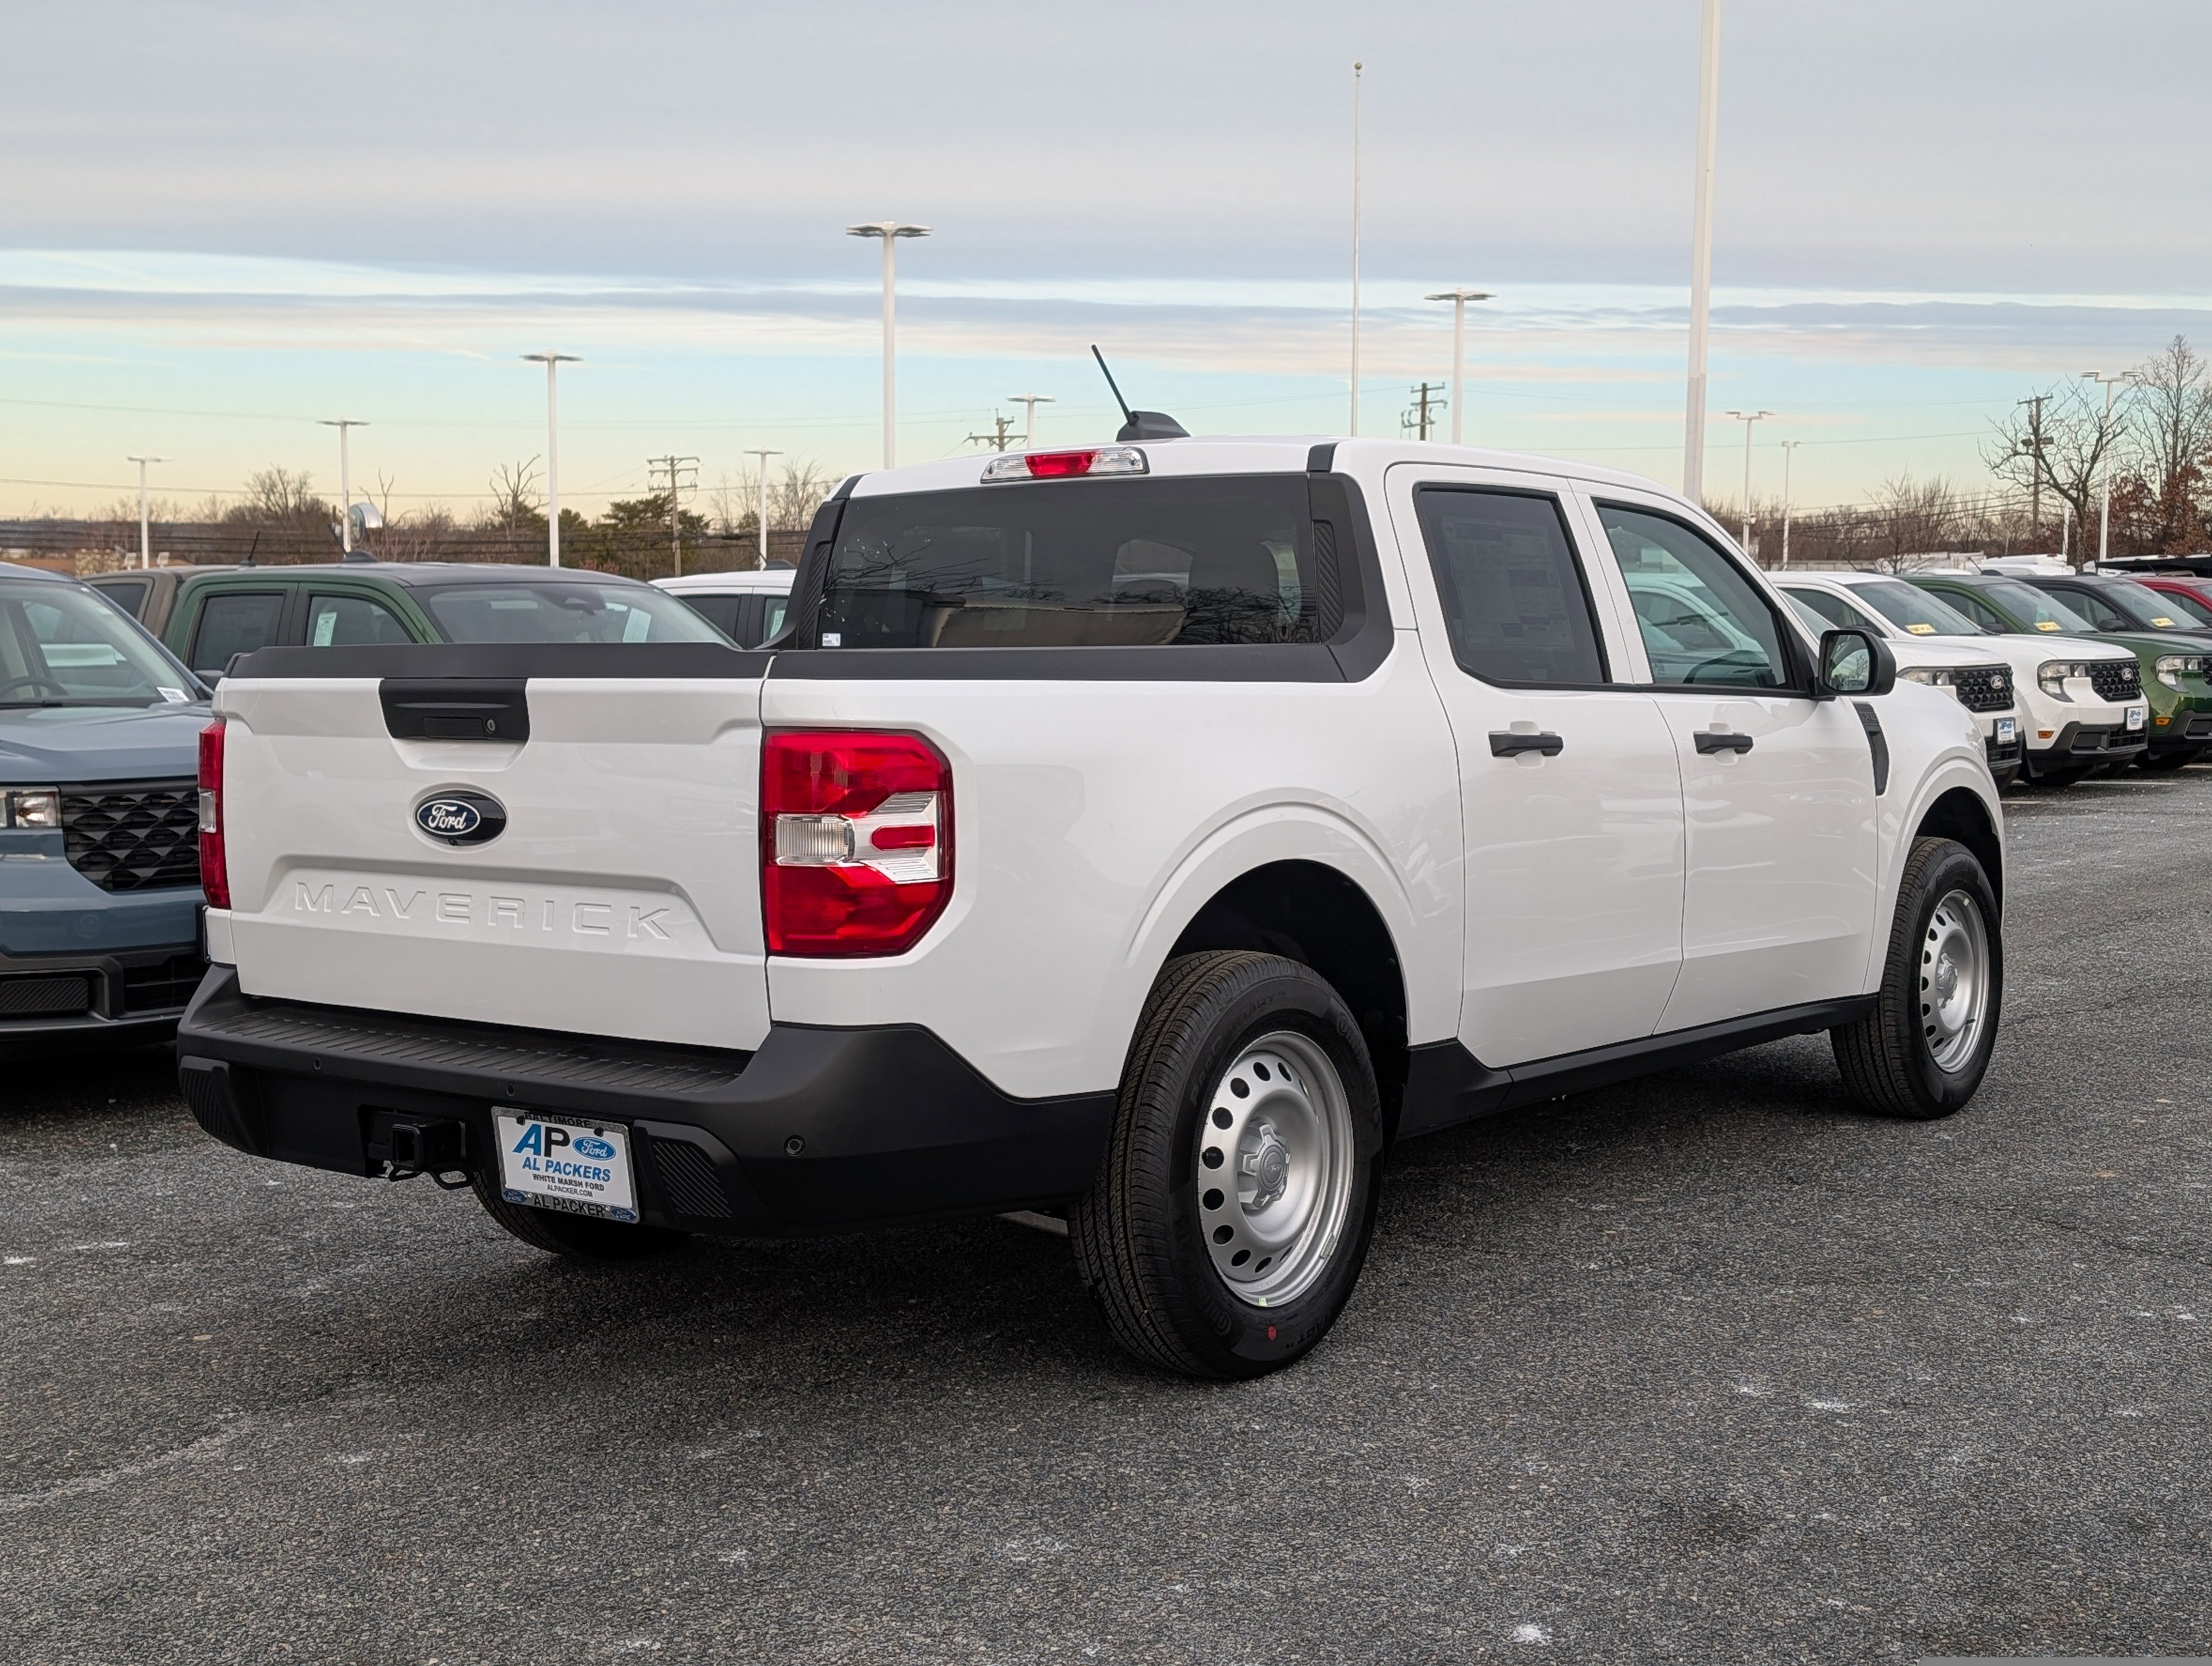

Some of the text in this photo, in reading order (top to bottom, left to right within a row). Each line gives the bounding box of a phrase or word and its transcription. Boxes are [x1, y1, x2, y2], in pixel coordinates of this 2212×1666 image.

[1862, 713, 1876, 721] XL
[428, 805, 467, 830] Ford
[294, 882, 671, 940] MAVERICK
[524, 1112, 591, 1128] BALTIMORE
[512, 1123, 608, 1158] AP Ford
[522, 1156, 611, 1182] AL PACKERS
[532, 1173, 605, 1191] WHITE MARSH FORD
[546, 1184, 593, 1197] ALPACKER.COM
[533, 1194, 605, 1218] AL PACKER
